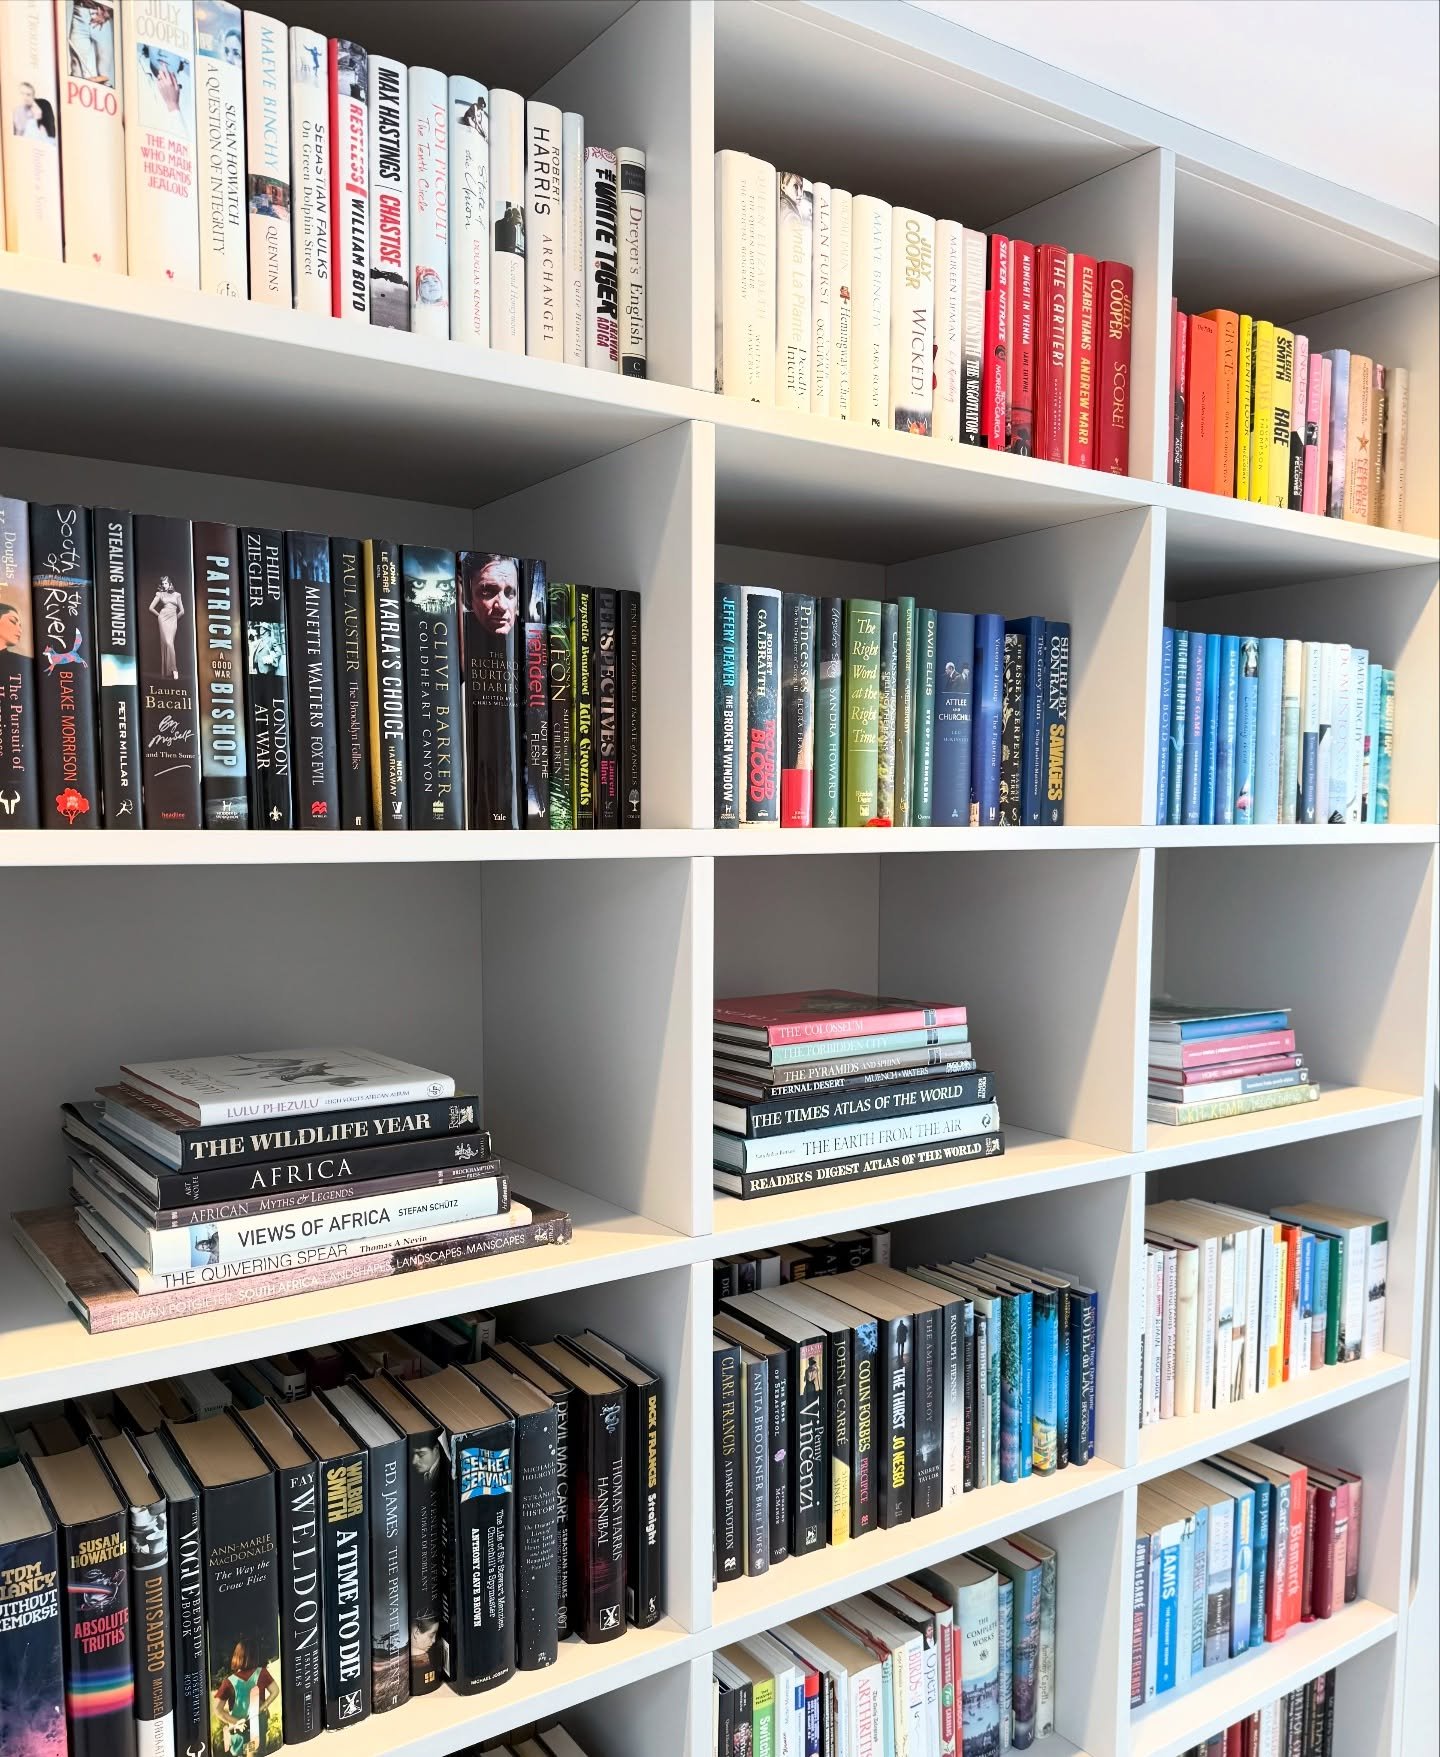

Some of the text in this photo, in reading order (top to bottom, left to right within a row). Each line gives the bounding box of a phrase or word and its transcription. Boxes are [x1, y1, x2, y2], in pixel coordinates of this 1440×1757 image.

[67, 81, 118, 116] POLO
[262, 27, 279, 171] MAEVE BINCHY
[141, 147, 192, 171] WHO MADE
[146, 133, 188, 153] THE MAN
[144, 161, 192, 186] HUSBANDS
[148, 176, 189, 198] JEALOUS
[378, 67, 401, 267] MAX HASTINGS CHASTISE
[533, 127, 551, 216] HARRIS
[551, 147, 561, 205] ROBERT
[349, 103, 367, 311] RESTLESS WILLIAM BOYD
[265, 226, 278, 292] QUENTINS
[625, 206, 643, 345] Dreyer's English
[542, 234, 554, 341] ARCHANGEL
[998, 241, 1007, 342] SILVER NITRATE
[1109, 279, 1124, 341] COOPER
[1052, 259, 1066, 369] THE CARTIERS
[1121, 293, 1132, 334] JILLY
[911, 308, 927, 397] WICKED!
[1078, 267, 1093, 445] ELIZABETHANS ANDREW MARR
[1275, 335, 1287, 382] SMITH
[1283, 339, 1293, 383] WILBUR
[1111, 362, 1127, 429] SCORE!
[1273, 406, 1290, 448] RAGE
[108, 522, 126, 647] STEALING THUNDER
[247, 534, 263, 608] ZIEGLER
[265, 545, 280, 601] PHILIP
[722, 596, 735, 687] JEFFERY DEAVER
[858, 618, 876, 635] The
[206, 556, 237, 766] PATRICK BISHOP
[212, 660, 232, 670] GOOD
[219, 652, 225, 660] A
[378, 598, 403, 740] KARLA'S CHOICE
[756, 609, 767, 697] GALBRAITH
[800, 605, 812, 694] Princesses
[852, 641, 879, 661] Right
[853, 664, 876, 679] Word
[149, 685, 187, 696] Lauren
[214, 670, 231, 679] WAR
[304, 586, 325, 786] MINETTE WALTERS FOX EVIL
[852, 684, 877, 699] at the
[1049, 637, 1060, 710] CONRAN
[1060, 637, 1069, 720] SHIRLEY
[145, 695, 192, 711] Bacall
[725, 695, 733, 710] THE
[851, 704, 876, 725] Right
[945, 698, 967, 706] ATTLEE
[59, 671, 78, 781] BLAKE MORRISON
[117, 701, 128, 787] PETER MILLAR
[254, 704, 271, 771] AT WAR
[272, 698, 288, 776] LONDON
[723, 710, 735, 751] BROKEN
[853, 728, 876, 744] Time
[145, 751, 196, 760] and Then Some
[723, 752, 735, 802] WINDOW
[1047, 724, 1065, 802] SAVAGES
[492, 812, 506, 821] Yale
[752, 1084, 962, 1129] THE TIMES ATLAS OF THE WORLD
[771, 1078, 845, 1096] ETERNAL DESERT
[190, 1112, 431, 1160] THE WILDLIFE YEAR
[250, 1158, 353, 1189] AFRICA
[749, 1143, 982, 1191] READER'S DIGEST ATLAS OF THE WORLD
[189, 1203, 249, 1223] AFRICAN
[260, 1196, 295, 1211] MYTHS
[311, 1188, 354, 1203] LEGENDS
[237, 1207, 391, 1248] VIEWS OF AFRICA
[398, 1198, 459, 1217] STEFAN SCHÜTZ
[161, 1243, 348, 1289] THE QUIVERING SPEAR
[359, 1242, 392, 1254] Thomas
[400, 1235, 427, 1246] Nevin
[893, 1367, 905, 1390] THE
[893, 1392, 905, 1430] THIRST
[799, 1396, 821, 1513] Vincenzi
[814, 1425, 825, 1462] Penny
[893, 1436, 905, 1450] JO
[290, 1472, 315, 1489] FAY
[345, 1461, 363, 1517] WILBUR
[646, 1394, 657, 1546] DICK FRANCIS Straight
[327, 1468, 346, 1523] SMITH
[70, 1542, 127, 1569] HOWATCH
[78, 1532, 121, 1555] SUSAN
[210, 1533, 272, 1556] ANN-MARIE
[214, 1560, 271, 1580] The Way the
[218, 1573, 267, 1593] Crow Flies
[291, 1485, 319, 1652] WELDON
[74, 1607, 129, 1639] ABSOLUTE
[144, 1575, 166, 1672] DIVISADERO
[336, 1530, 361, 1683] A TIME TO DIE
[81, 1627, 125, 1655] TRUTHS
